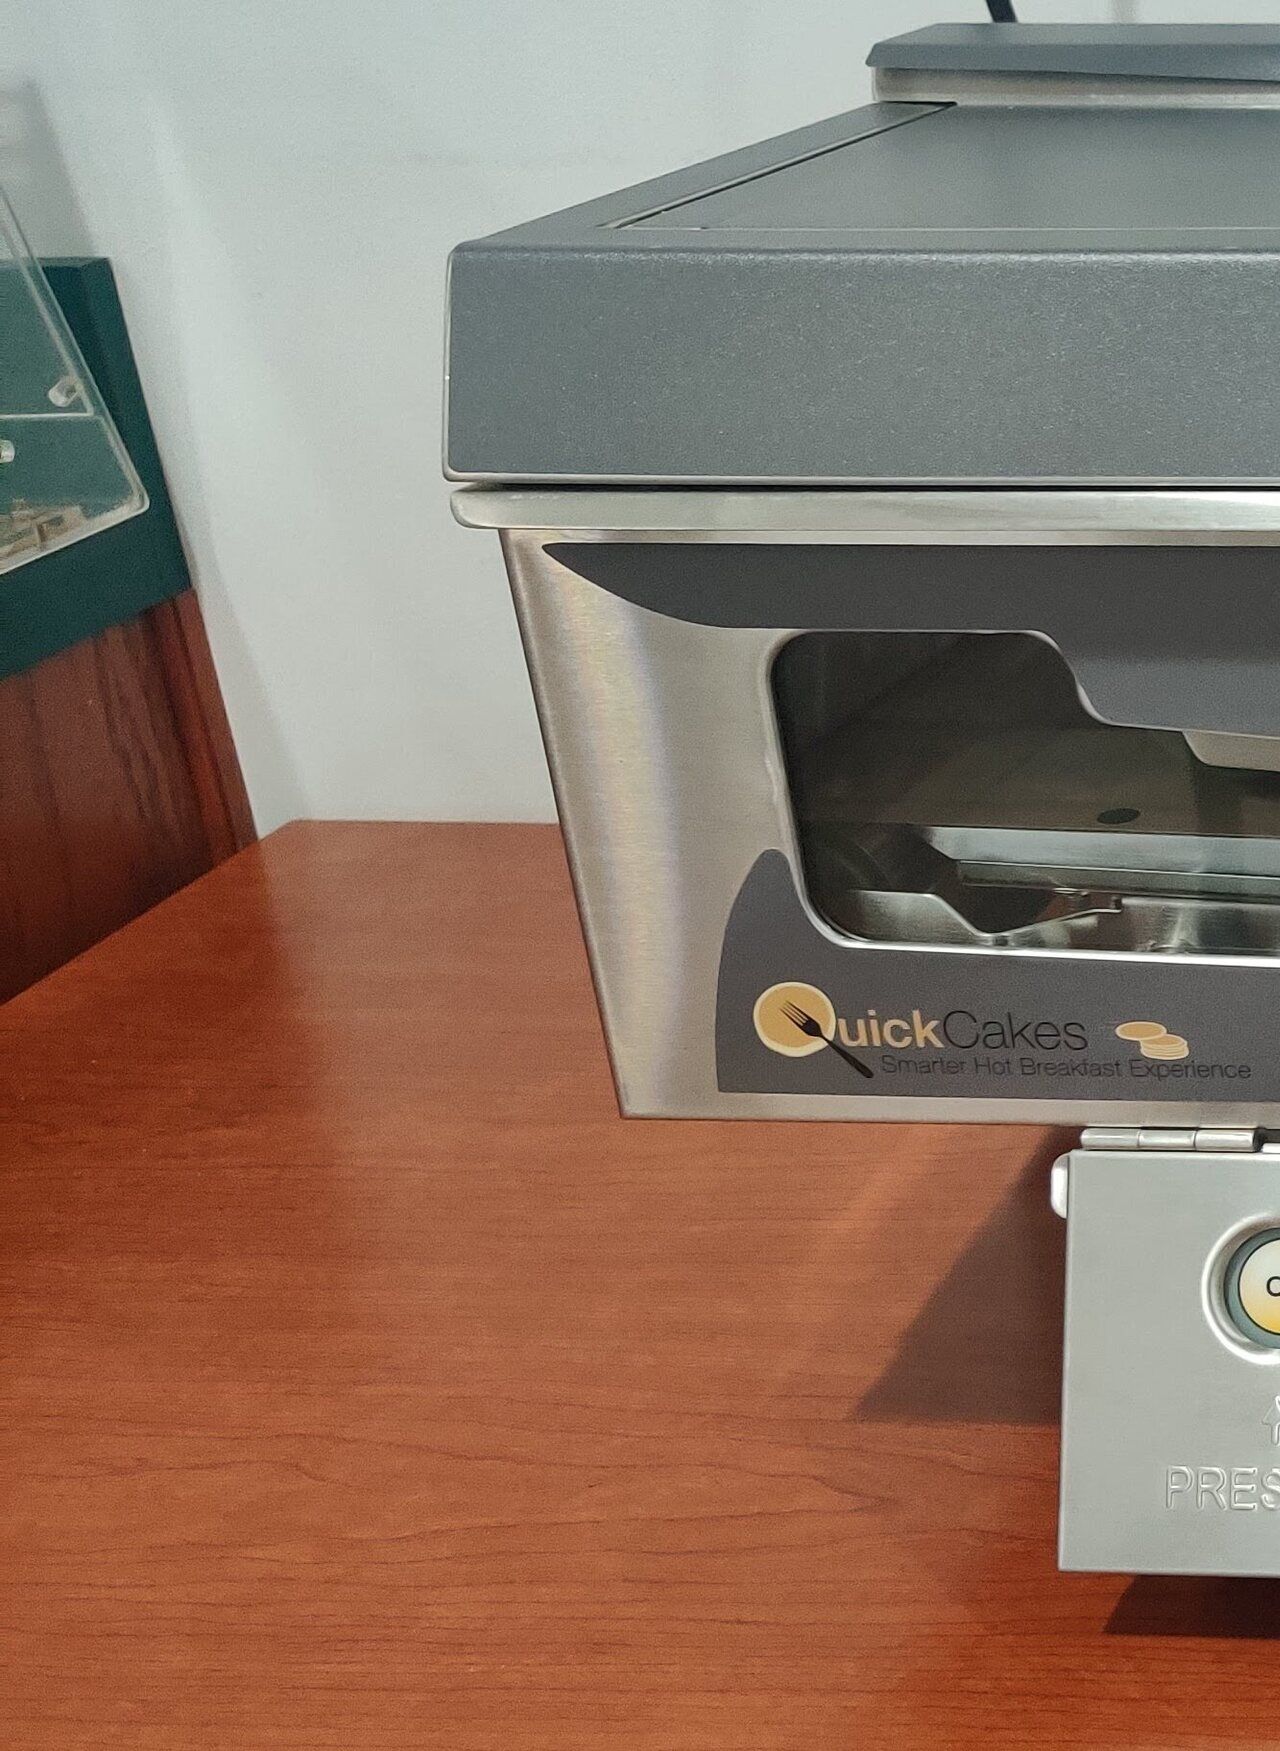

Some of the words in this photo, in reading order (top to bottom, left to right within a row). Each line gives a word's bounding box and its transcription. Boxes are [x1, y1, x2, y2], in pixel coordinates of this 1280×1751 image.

[881, 1054, 966, 1076] Smarter
[975, 1056, 1012, 1076] Hot
[1020, 1057, 1121, 1079] Breakfast
[1129, 1058, 1252, 1082] Experience
